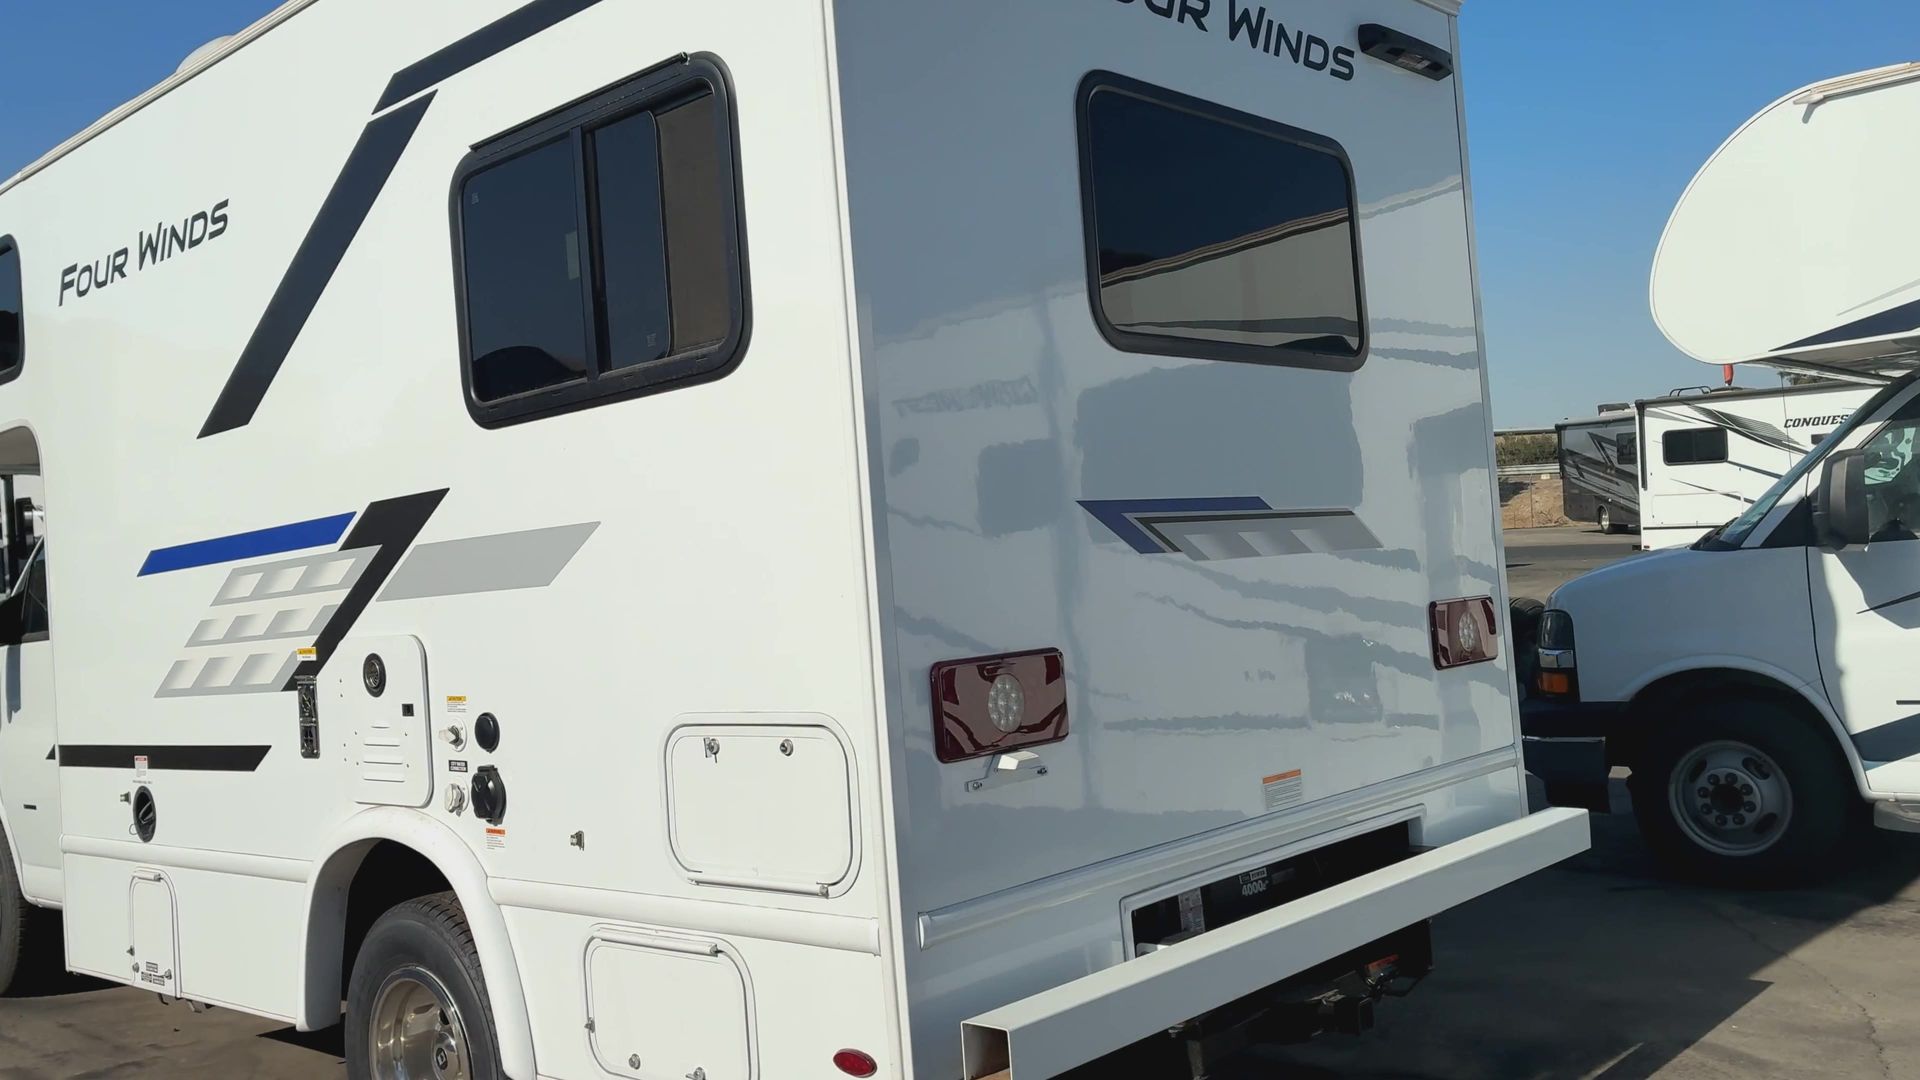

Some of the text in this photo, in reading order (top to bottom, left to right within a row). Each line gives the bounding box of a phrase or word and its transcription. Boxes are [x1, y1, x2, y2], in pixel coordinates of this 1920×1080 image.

[58, 198, 230, 307] FOUR WINDS
[1783, 414, 1849, 429] CONQUES
